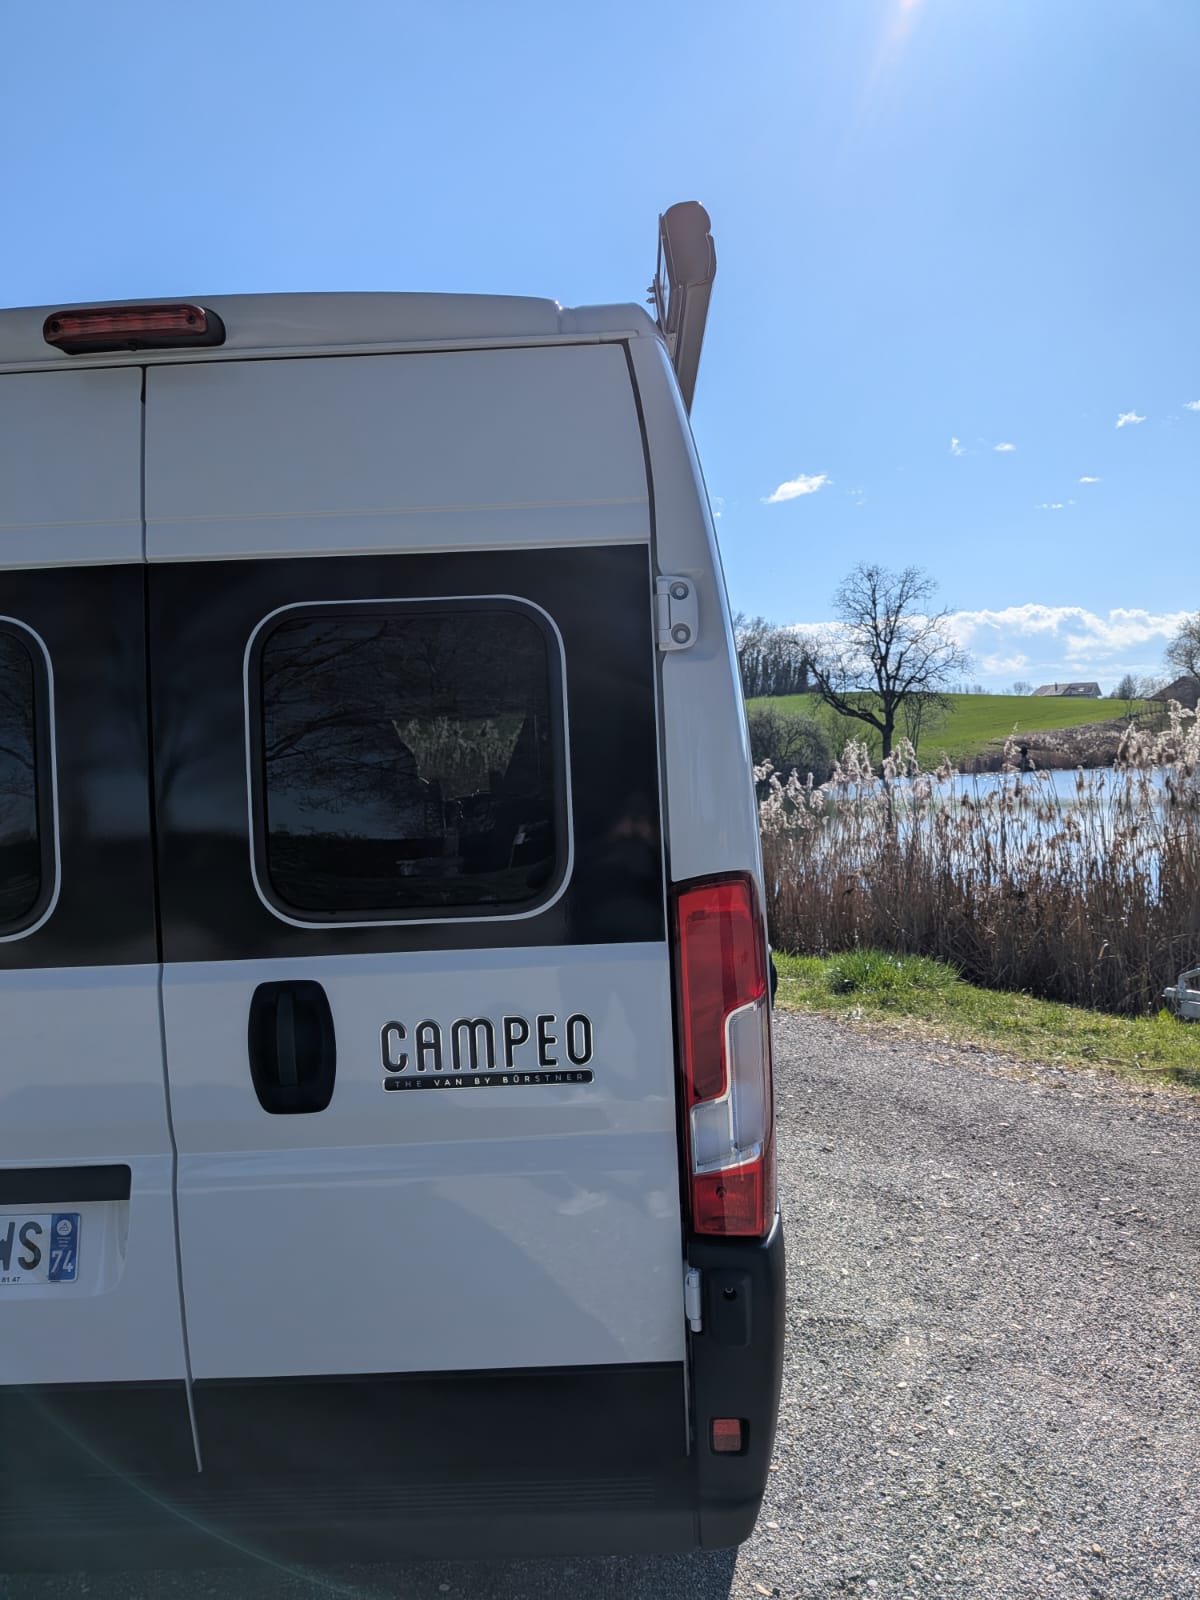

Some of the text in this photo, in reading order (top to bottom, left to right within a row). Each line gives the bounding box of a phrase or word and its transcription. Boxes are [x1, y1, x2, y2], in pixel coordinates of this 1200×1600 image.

[380, 1013, 594, 1073] CAMPEO
[395, 1080, 424, 1088] THE
[433, 1078, 463, 1087] VAN
[474, 1077, 491, 1085] BY
[51, 1250, 74, 1272] 74
